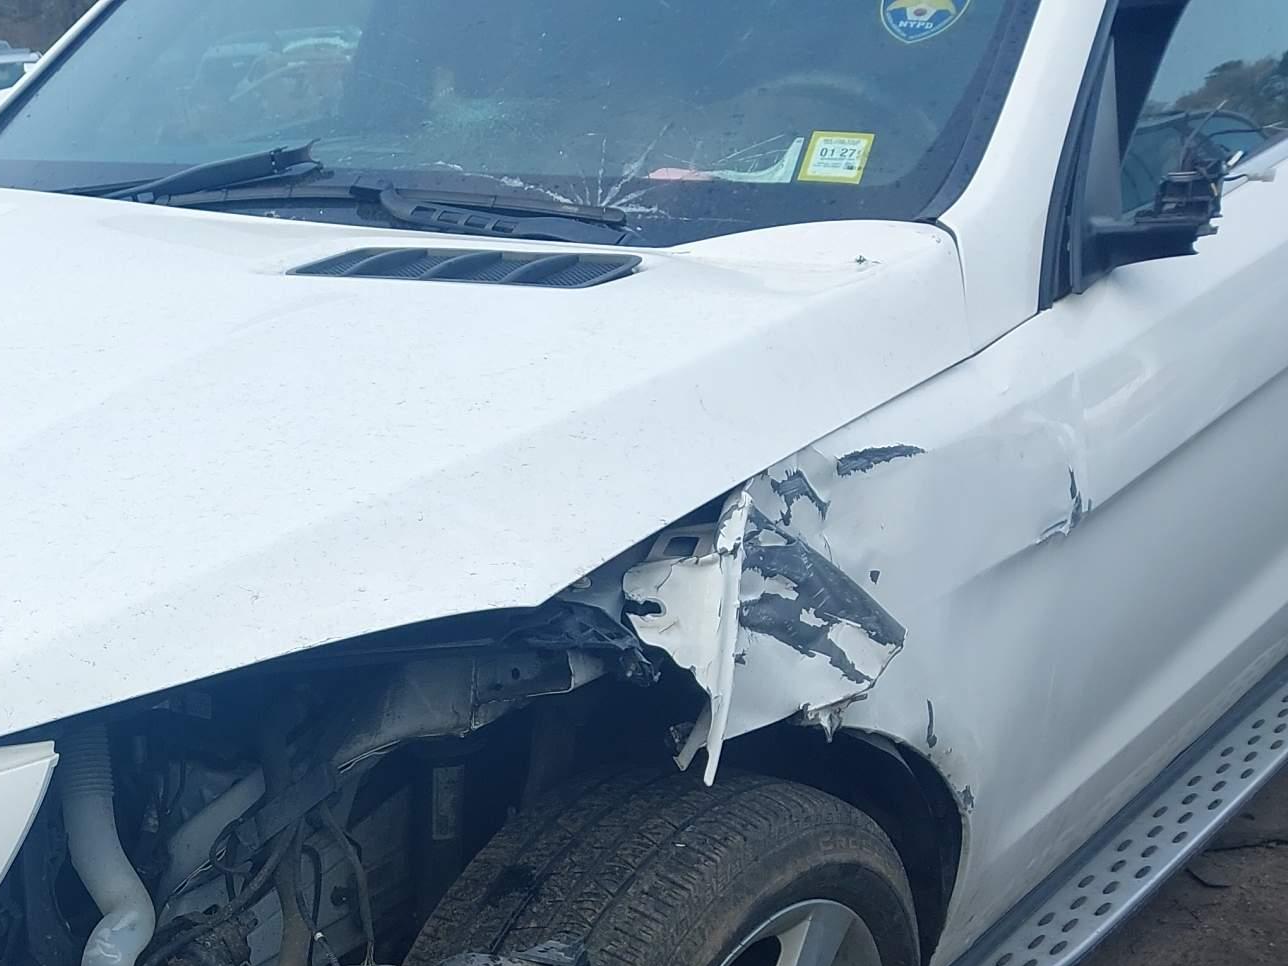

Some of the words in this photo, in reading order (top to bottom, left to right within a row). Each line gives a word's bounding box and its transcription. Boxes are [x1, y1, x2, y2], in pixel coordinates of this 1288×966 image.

[898, 20, 934, 30] NYPD
[819, 147, 836, 158] 01
[839, 148, 857, 158] 27
